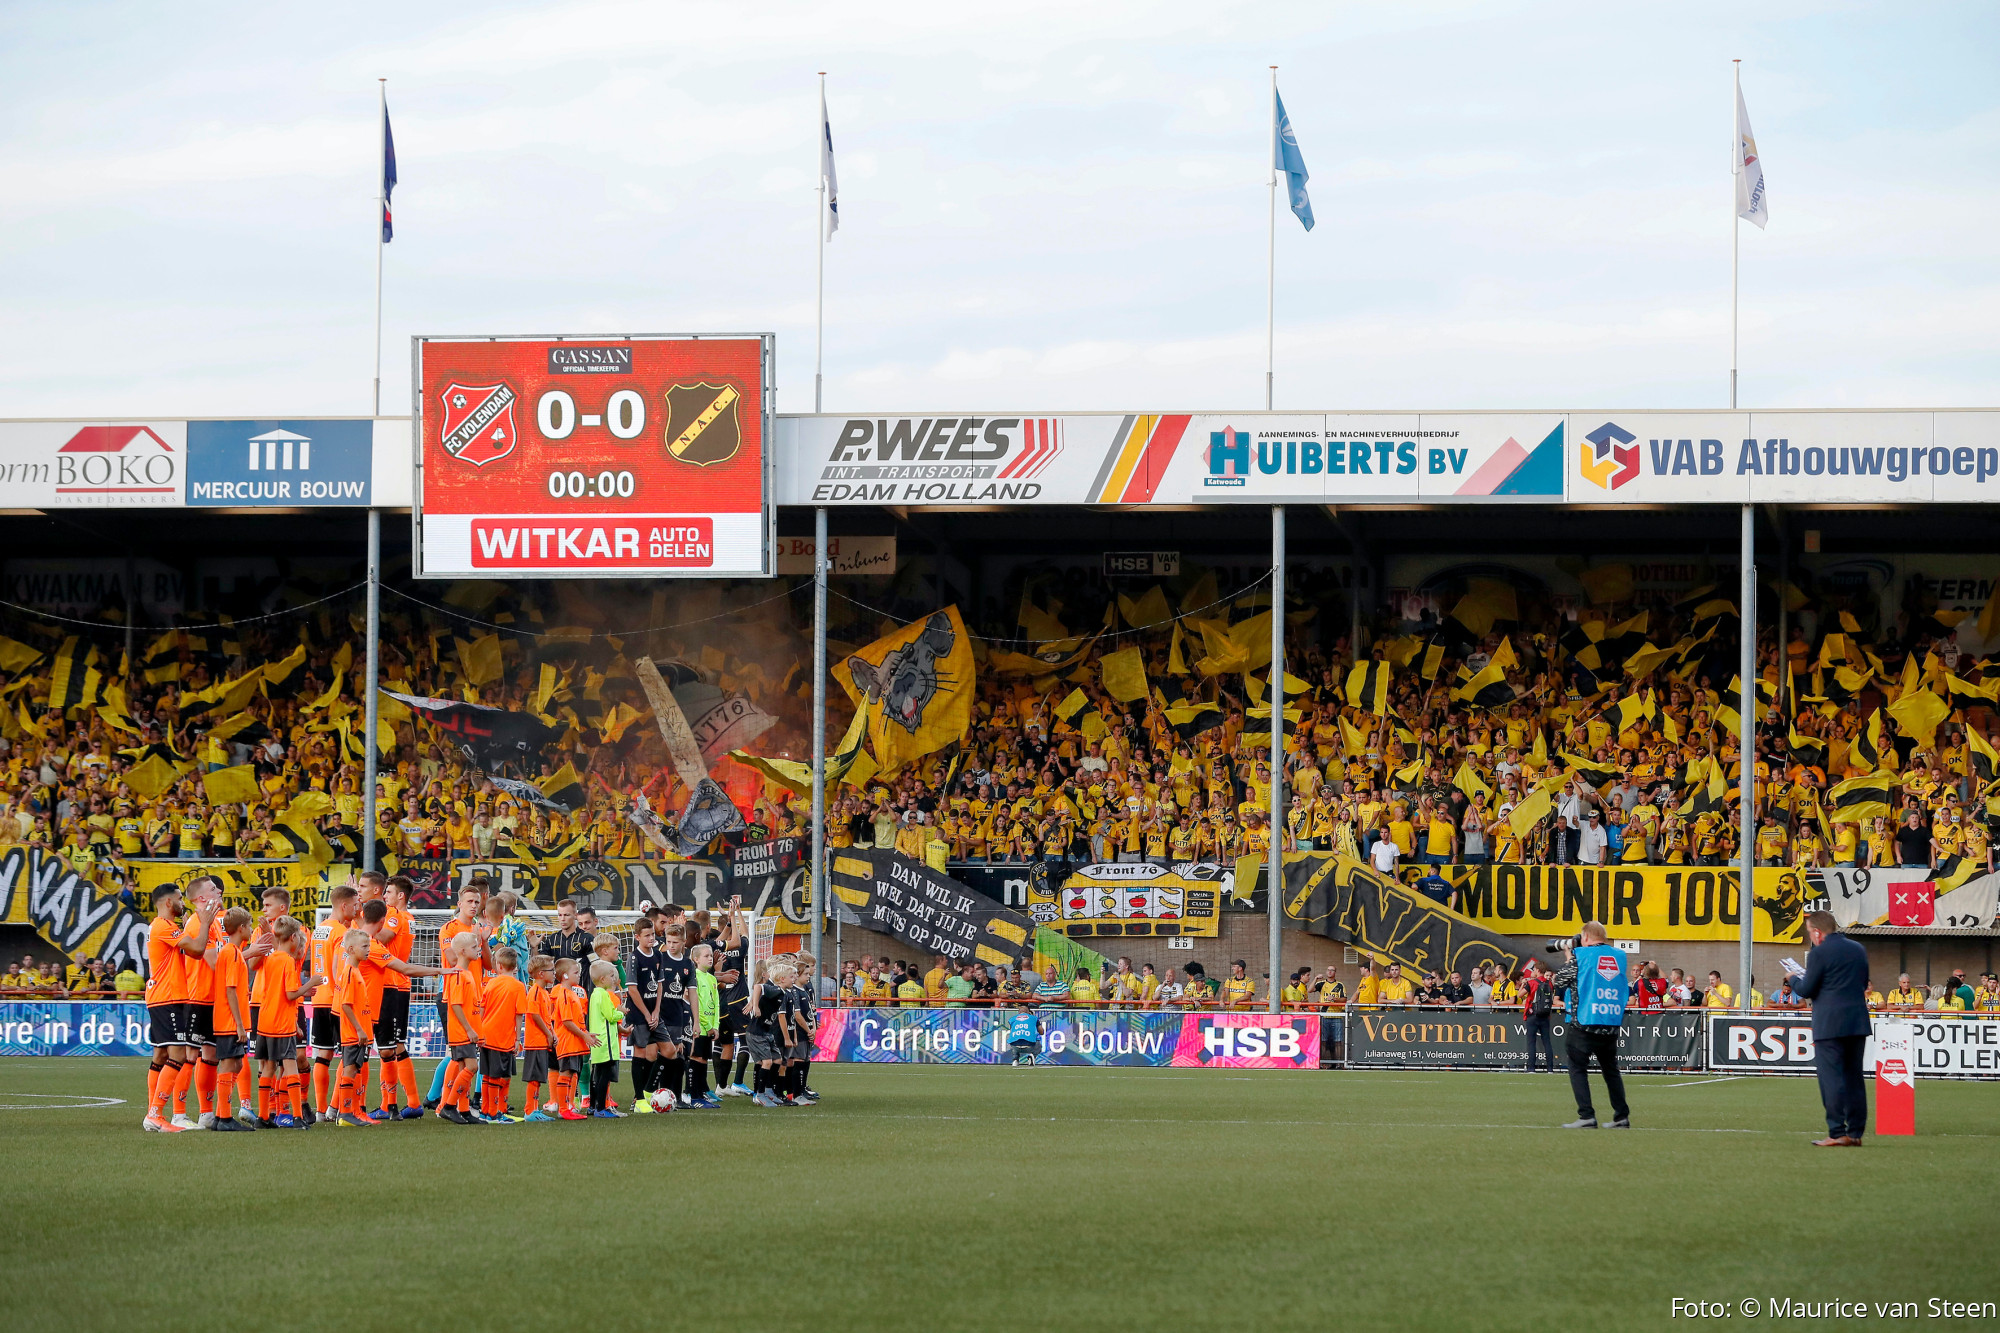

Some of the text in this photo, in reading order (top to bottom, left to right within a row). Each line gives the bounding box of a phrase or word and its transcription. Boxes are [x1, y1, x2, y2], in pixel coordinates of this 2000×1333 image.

[552, 349, 628, 364] GASSAN
[446, 387, 513, 454] FC VOLENDAM
[1210, 432, 1469, 475] HUIBERTS BV
[1650, 438, 1999, 483] VAB Afbouwgroep
[56, 455, 176, 485] BOKO
[828, 466, 989, 479] INT. TRANSPORT
[193, 481, 365, 499] MERCUUR BOUW
[548, 471, 636, 498] 00:00
[1207, 478, 1242, 486] Katwoude
[55, 496, 177, 504] DAKBEDEKKERS
[812, 483, 1042, 501] EDAM HOLLAND
[477, 528, 640, 558] WITKAR
[649, 527, 700, 542] AUTO
[650, 544, 710, 558] DELEN
[790, 538, 841, 556] Bod
[828, 550, 891, 574] Tribune
[1111, 557, 1149, 571] HSB
[1157, 553, 1178, 564] VAK
[1164, 563, 1172, 572] D
[1948, 756, 1963, 765] OK
[1316, 812, 1330, 823] OK
[1149, 835, 1163, 843] OK
[1939, 837, 1954, 845] OK
[734, 838, 794, 861] FRONT 76
[400, 858, 443, 872] GAAN
[733, 858, 778, 877] BREDA
[1090, 866, 1158, 876] Front 76
[890, 861, 976, 916] DAN WIL IK
[1834, 868, 1872, 900] 19
[1452, 864, 1741, 927] MOUNIR 100
[876, 880, 978, 941] WEL DAT JIJ JE
[1035, 904, 1053, 912] FCK
[873, 904, 971, 960] MUTS OP DOET
[315, 943, 324, 973] 5
[1597, 988, 1619, 1000] 062
[1591, 1003, 1621, 1015] FOTO
[45, 1013, 69, 1045] in
[80, 1013, 115, 1045] de
[859, 1019, 981, 1053] Carriere
[1078, 1021, 1164, 1055] bouw
[1361, 1015, 1508, 1044] Veerman
[1204, 1027, 1301, 1059] HSB
[1364, 1050, 1407, 1061] Julianaweg
[1408, 1051, 1424, 1061] 151,
[1425, 1050, 1465, 1060] Volendam
[1484, 1051, 1497, 1060] tel.
